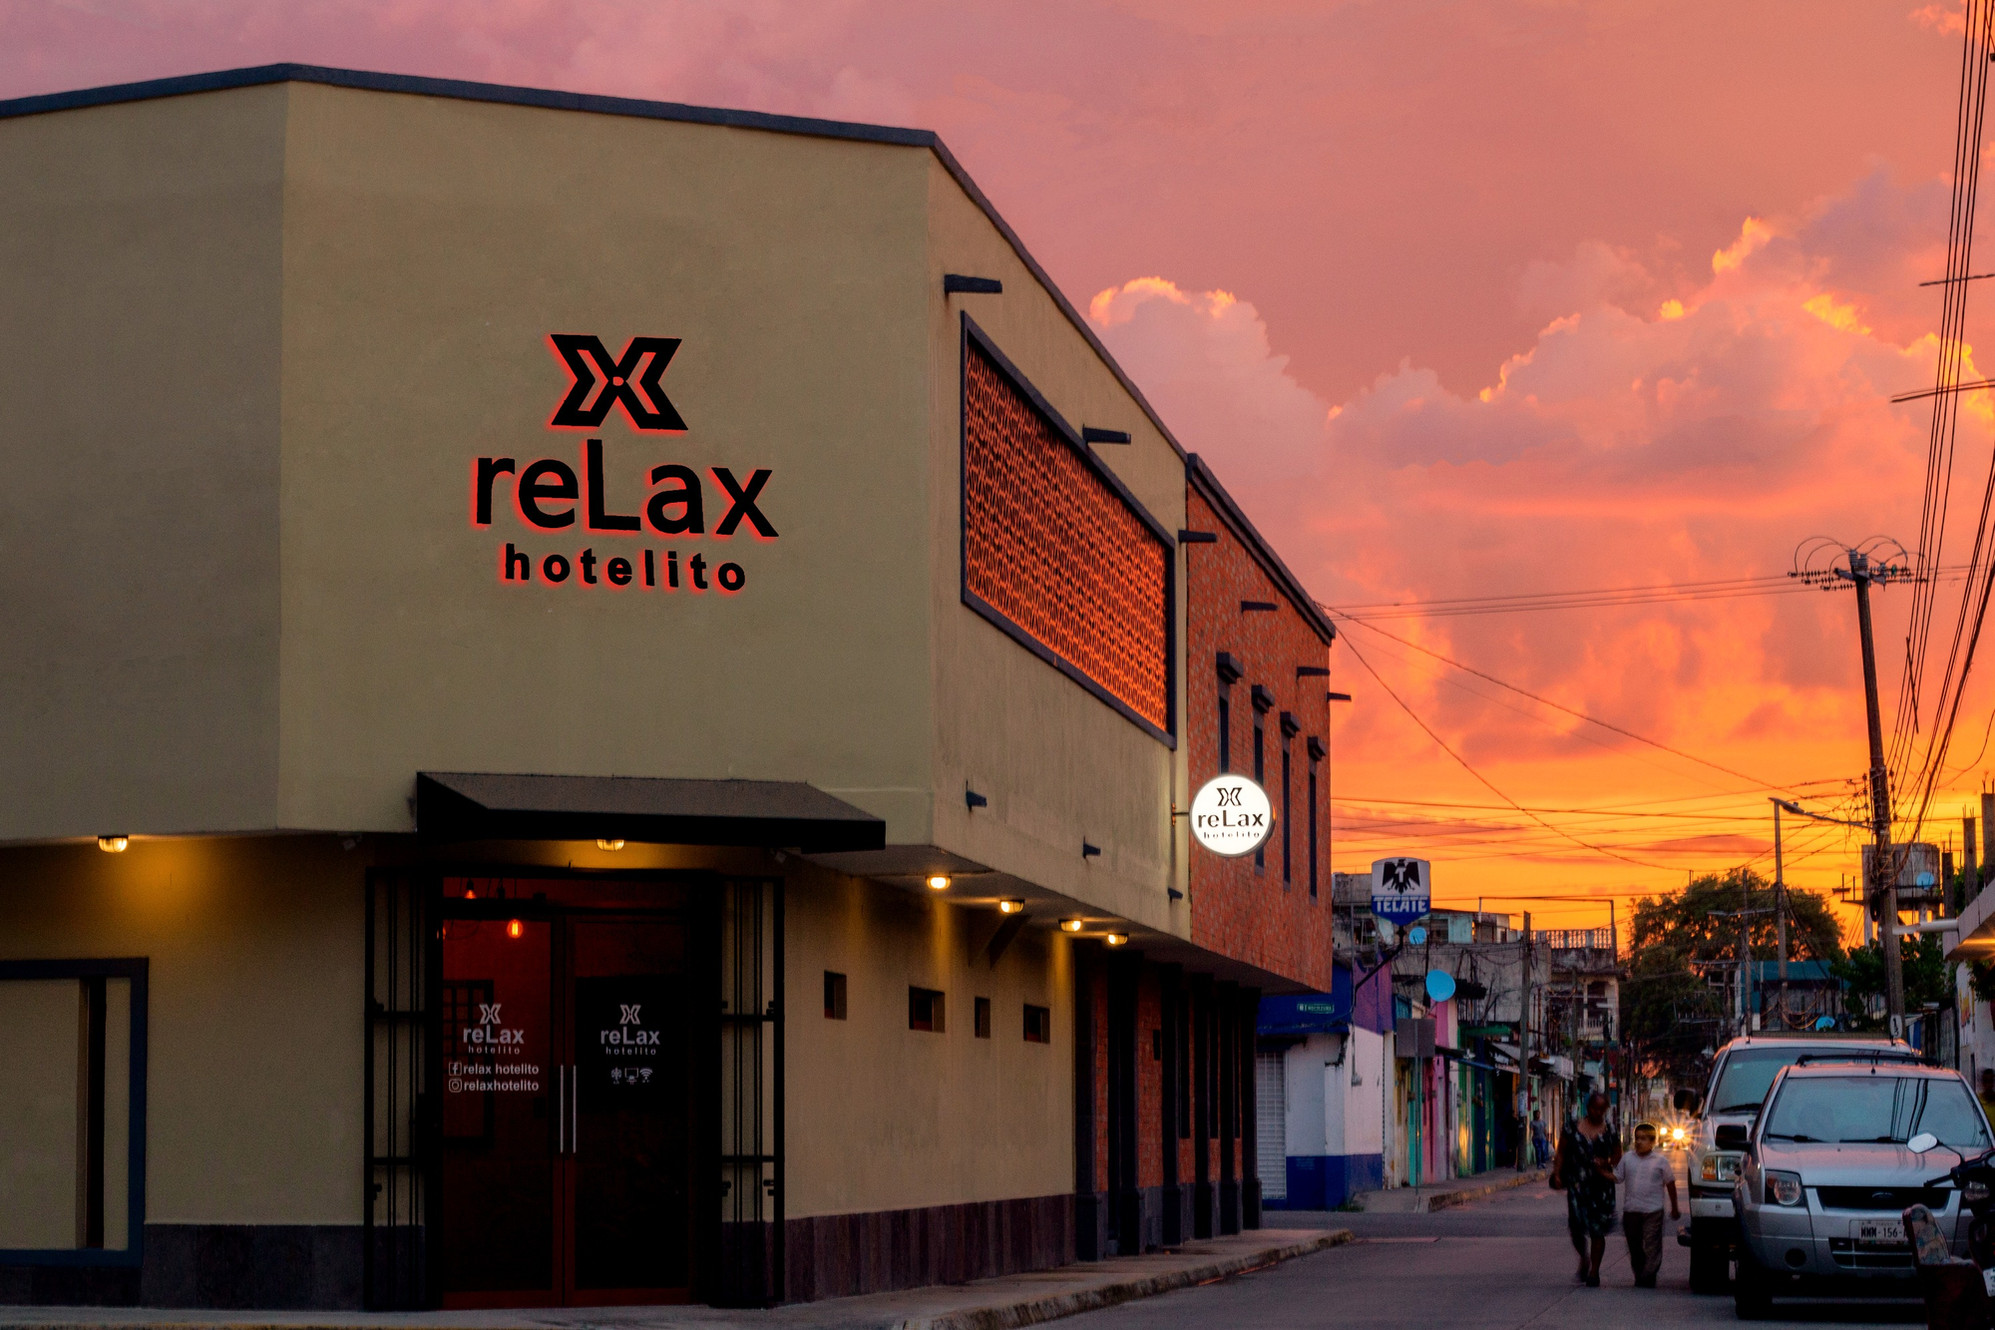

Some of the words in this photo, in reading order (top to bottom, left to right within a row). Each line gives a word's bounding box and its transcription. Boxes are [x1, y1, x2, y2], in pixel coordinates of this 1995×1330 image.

[475, 438, 779, 538] reLax
[504, 542, 746, 592] hotelito
[1197, 809, 1264, 828] reLax
[1203, 831, 1260, 839] hotelito
[1373, 896, 1429, 913] TECATE
[463, 1025, 525, 1045] reLax
[600, 1026, 661, 1045] reLax
[468, 1045, 521, 1055] hotelito
[605, 1046, 657, 1056] hotelito
[463, 1063, 492, 1075] relax
[495, 1062, 540, 1075] hotelito
[463, 1079, 540, 1092] relaxhotelito
